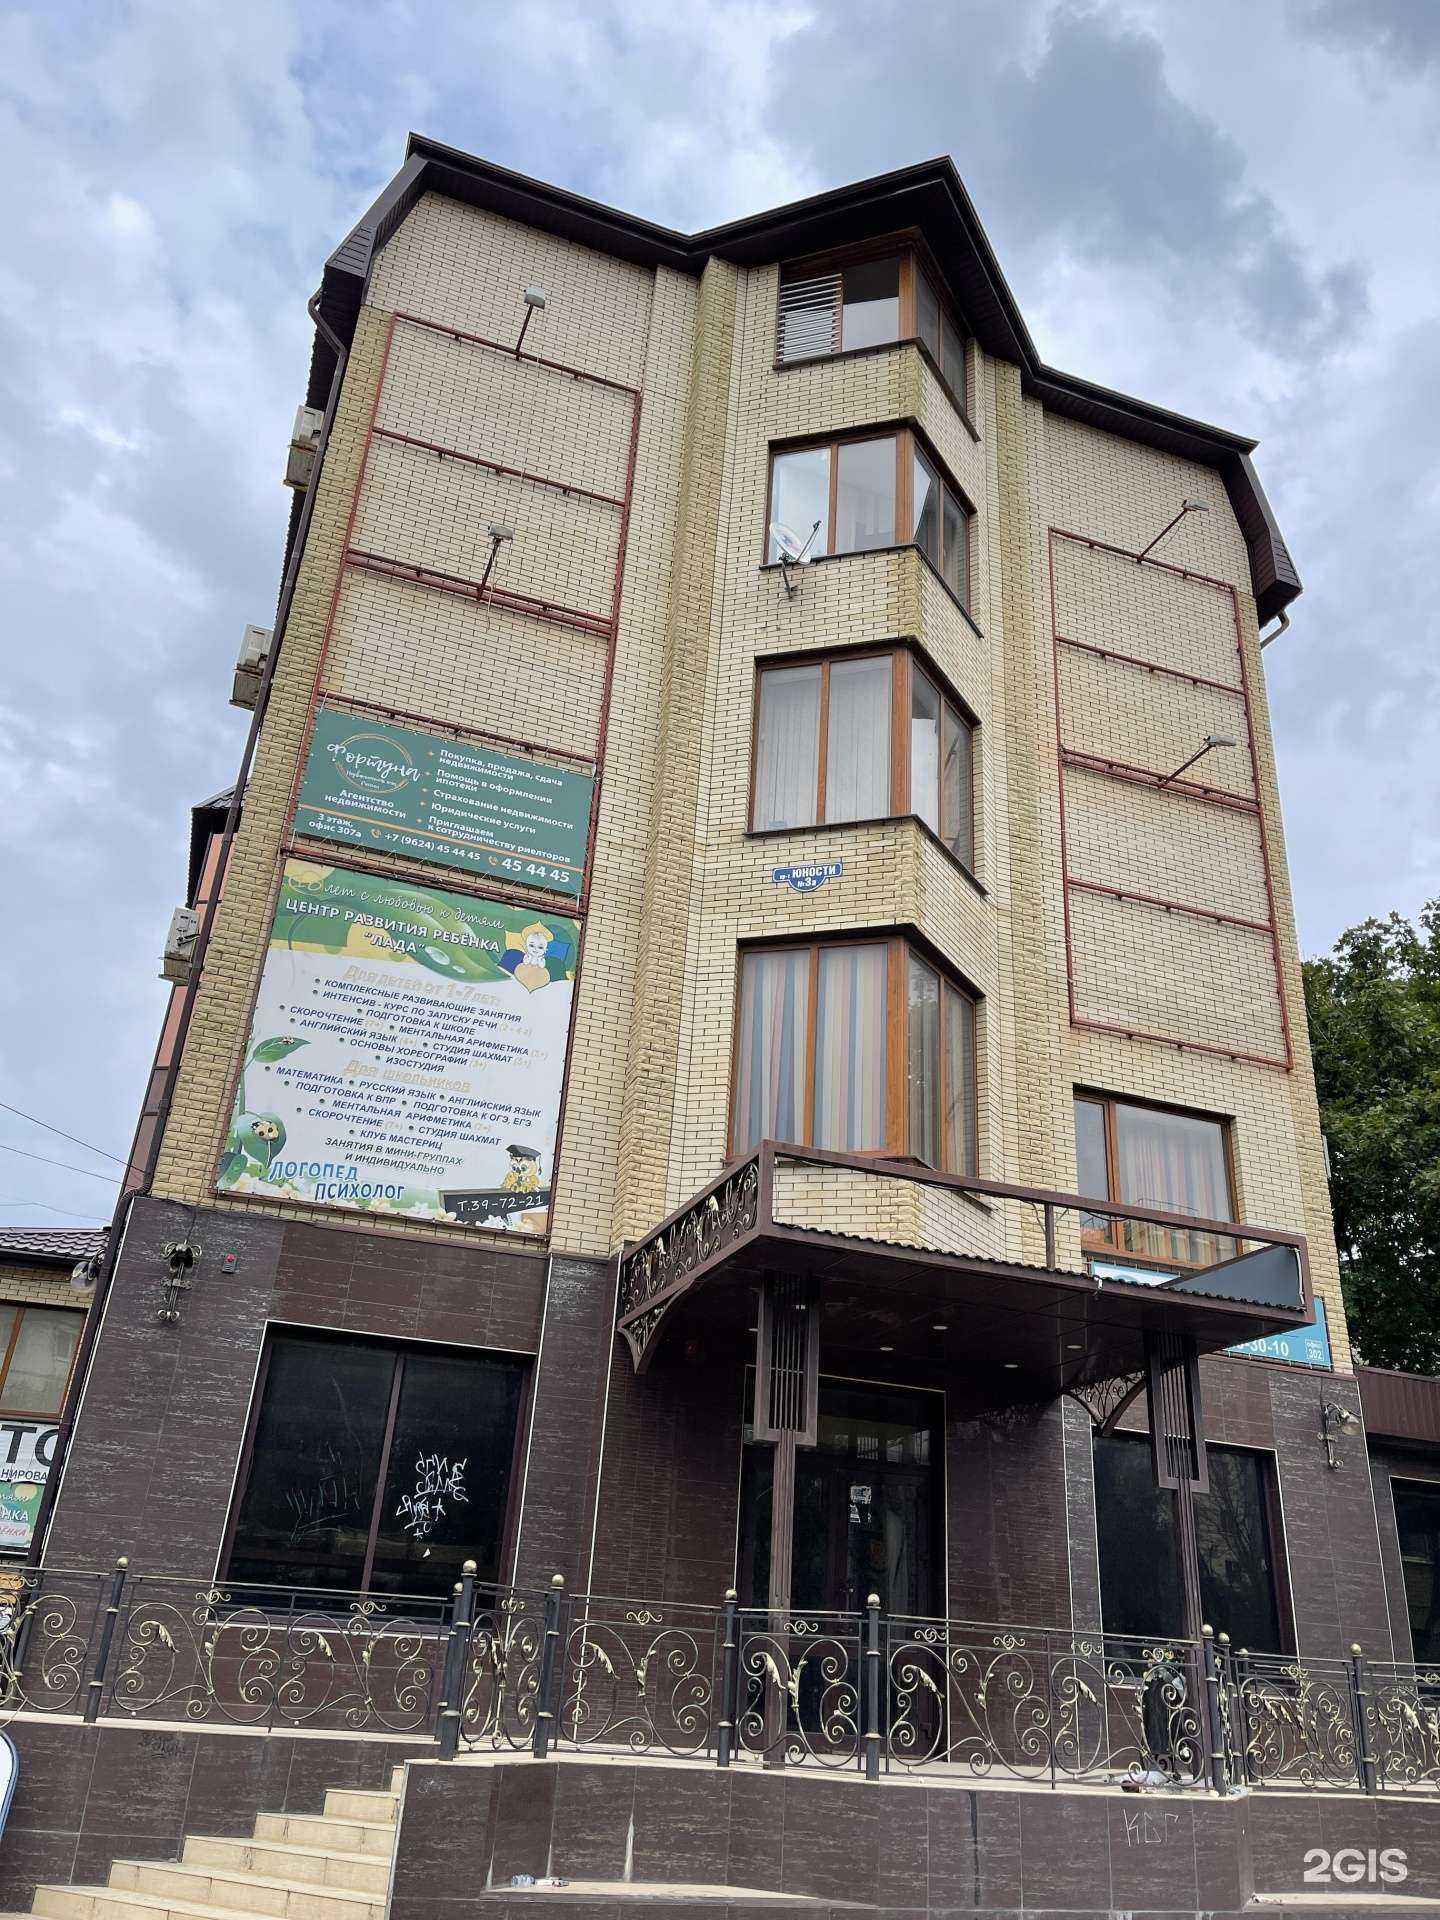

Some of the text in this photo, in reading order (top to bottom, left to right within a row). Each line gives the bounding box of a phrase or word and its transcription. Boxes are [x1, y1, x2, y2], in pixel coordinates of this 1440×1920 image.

[327, 744, 420, 781] Фортуна
[439, 757, 514, 781] недвижимости
[441, 749, 563, 787] Покупка, продажа, сдача
[339, 790, 394, 808] Агентство
[435, 778, 477, 792] ипотеки
[437, 768, 479, 786] Помощь
[489, 783, 553, 804] оформлении
[325, 795, 406, 819] недвижимости
[431, 803, 537, 835] Юридические услуги
[434, 789, 574, 830] Страхование недвижимости
[308, 820, 362, 837] офис 307а
[327, 816, 353, 827] этаж,
[429, 816, 494, 838] Приглашаем
[385, 833, 481, 861] +7 (9624) 45 44 45
[436, 826, 516, 851] сотрудничеству
[517, 845, 571, 863] риелторов
[502, 858, 570, 883] 45 44 45
[792, 865, 836, 879] ЮНОСТИ
[325, 884, 355, 896] лет
[360, 892, 369, 901] с
[374, 894, 434, 914] любовью
[440, 909, 451, 918] к
[455, 907, 504, 929] детям
[286, 898, 500, 952] ЦЕНТР РАЗВИТИЯ РЕБЁНКА
[323, 991, 377, 1007] ИНТЕНСИВ
[384, 1001, 409, 1013] КУРС
[411, 1008, 425, 1016] ПО
[427, 1010, 470, 1024] ЗАПУСКУ
[472, 1018, 498, 1029] РЕЧИ
[325, 979, 522, 1022] КОМПЛЕКСНЫЕ РАЗВИВАЮЩИЕ ЗАНЯТИЯ
[290, 1006, 364, 1026] СКОРОЧТЕНИЕ
[399, 1025, 465, 1044] МЕНТАЛЬНАЯ
[465, 1038, 529, 1056] АРИФМЕТИКА
[366, 1009, 476, 1036] ПОДГОТОВКА К ШКОЛЕ
[300, 1020, 367, 1038] АНГЛИЙСКИЙ
[368, 1032, 398, 1043] ЯЗЫК
[433, 1042, 470, 1055] СТУДИЯ
[472, 1050, 513, 1063] ШАХМАТ
[350, 1038, 394, 1053] ОСНОВЫ
[396, 1046, 468, 1066] ХОРЕОГРАФИИ
[343, 1059, 377, 1076] Для
[386, 1056, 445, 1073] ИЗОСТУДИЯ
[276, 1067, 541, 1118] МАТЕМАТИКА РУССКИЙ ЯЗЫК АНГЛИЙСКИЙ ЯЗЫК
[295, 1081, 532, 1127] ПОДГОТОВКА К ВПР ПОДГОТОВКА К ОГЭ, ЕГЭ
[308, 1108, 384, 1127] СКОРОЧТЕНИЕ
[418, 1126, 458, 1138] СТУДИЯ
[459, 1132, 502, 1146] ШАХМАТ
[332, 1100, 402, 1118] МЕНТАЛЬНАЯ
[405, 1112, 472, 1129] АРИФМЕТИКА
[325, 1138, 463, 1165] ЗАНЯТИЯ В МИНИ-ГРУППАХ
[360, 1130, 443, 1150] КЛУБ МАСТЕРИЦ
[269, 1161, 358, 1181] ЛОГОПЕД
[345, 1153, 445, 1175] И ИНДИВИДУАЛЬНО
[315, 1183, 404, 1200] ПСИХОЛОГ
